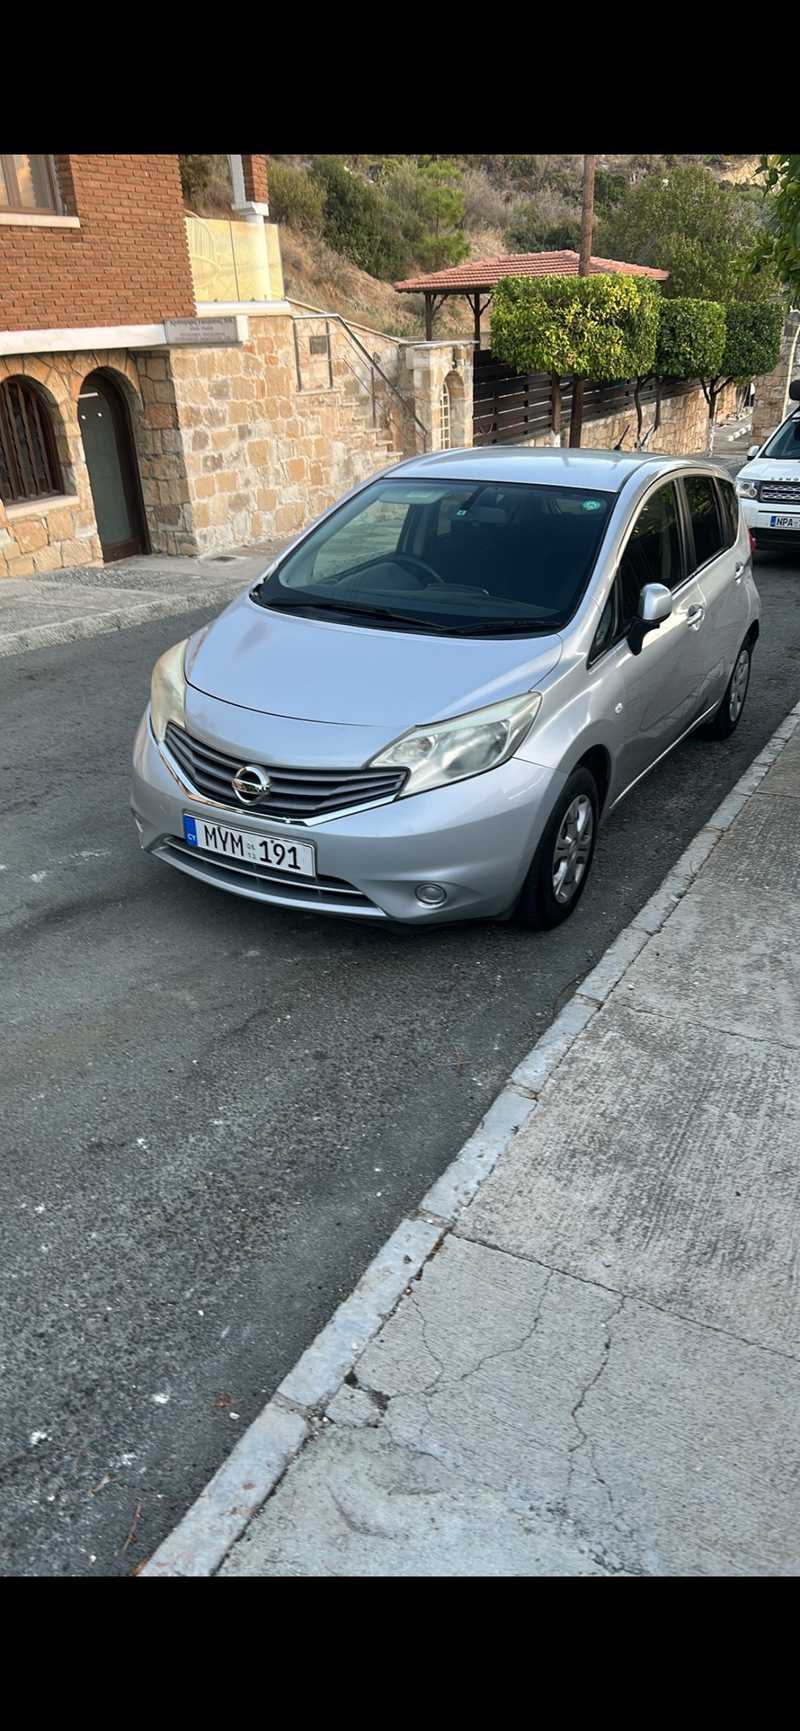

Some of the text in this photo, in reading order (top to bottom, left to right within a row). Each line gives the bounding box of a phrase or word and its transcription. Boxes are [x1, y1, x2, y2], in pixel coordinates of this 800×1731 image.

[776, 517, 793, 526] NPA
[204, 824, 301, 870] MYM 191
